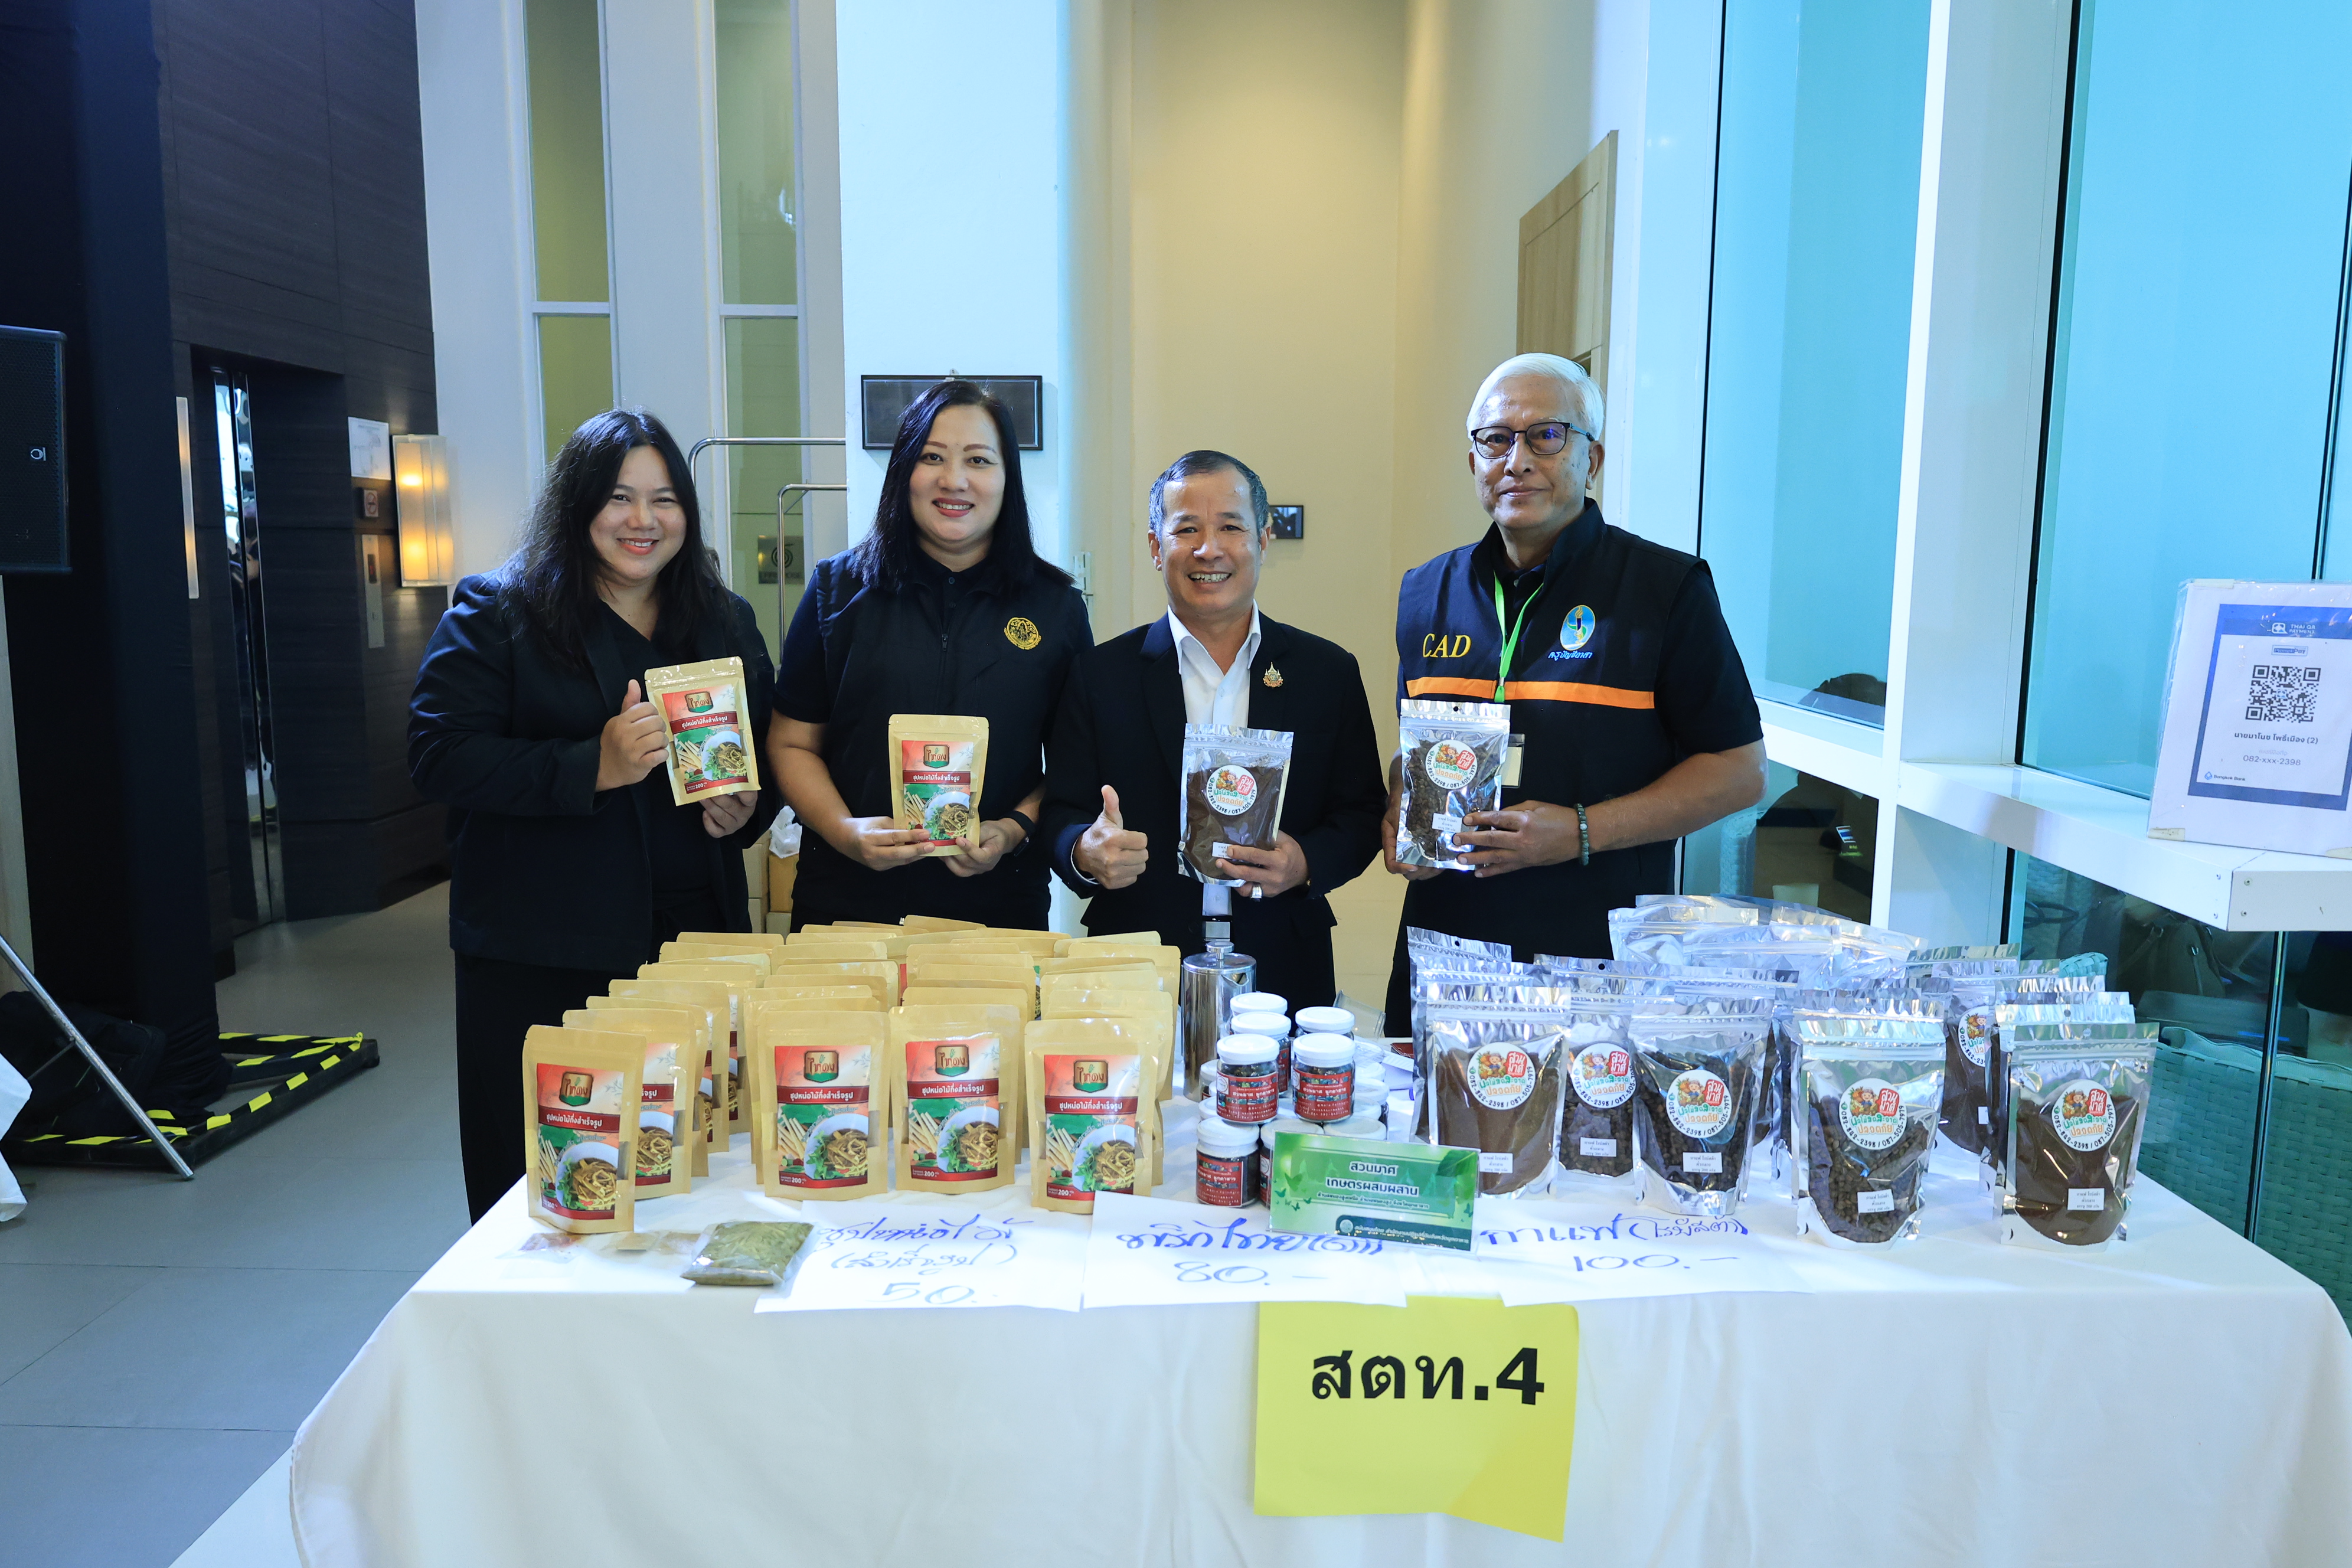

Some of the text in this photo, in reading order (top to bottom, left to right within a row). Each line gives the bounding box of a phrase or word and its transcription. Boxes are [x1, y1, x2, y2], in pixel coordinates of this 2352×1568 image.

[1423, 633, 1471, 658] CAD
[1547, 650, 1593, 661] ครูบัญชีอาสา
[1462, 752, 1474, 761] สวน
[2243, 755, 2301, 766] 082-xxx-2398
[1436, 769, 1462, 780] ปลอดภัย
[1241, 776, 1253, 786] สวน
[1217, 795, 1243, 806] ปลอดภัย
[1960, 1034, 1985, 1064] 082-842-23
[1509, 1053, 1525, 1063] สวน
[1612, 1052, 1628, 1063] สวน
[1487, 1084, 1521, 1096] ปลอดภัย
[1591, 1083, 1625, 1095] ปลอดภัย
[1707, 1080, 1723, 1092] สวน
[1881, 1090, 1897, 1102] สวน
[2090, 1090, 2106, 1102] สวน
[1684, 1113, 1718, 1123] ปลอดภัย
[1858, 1123, 1893, 1133] ปลอดภัย
[2071, 1124, 2103, 1136] ปลอดภัย
[1350, 1161, 1397, 1175] สวนมาศ
[1327, 1178, 1418, 1196] เกษตรผสมผสาน
[1312, 1347, 1544, 1405] สตท.4
